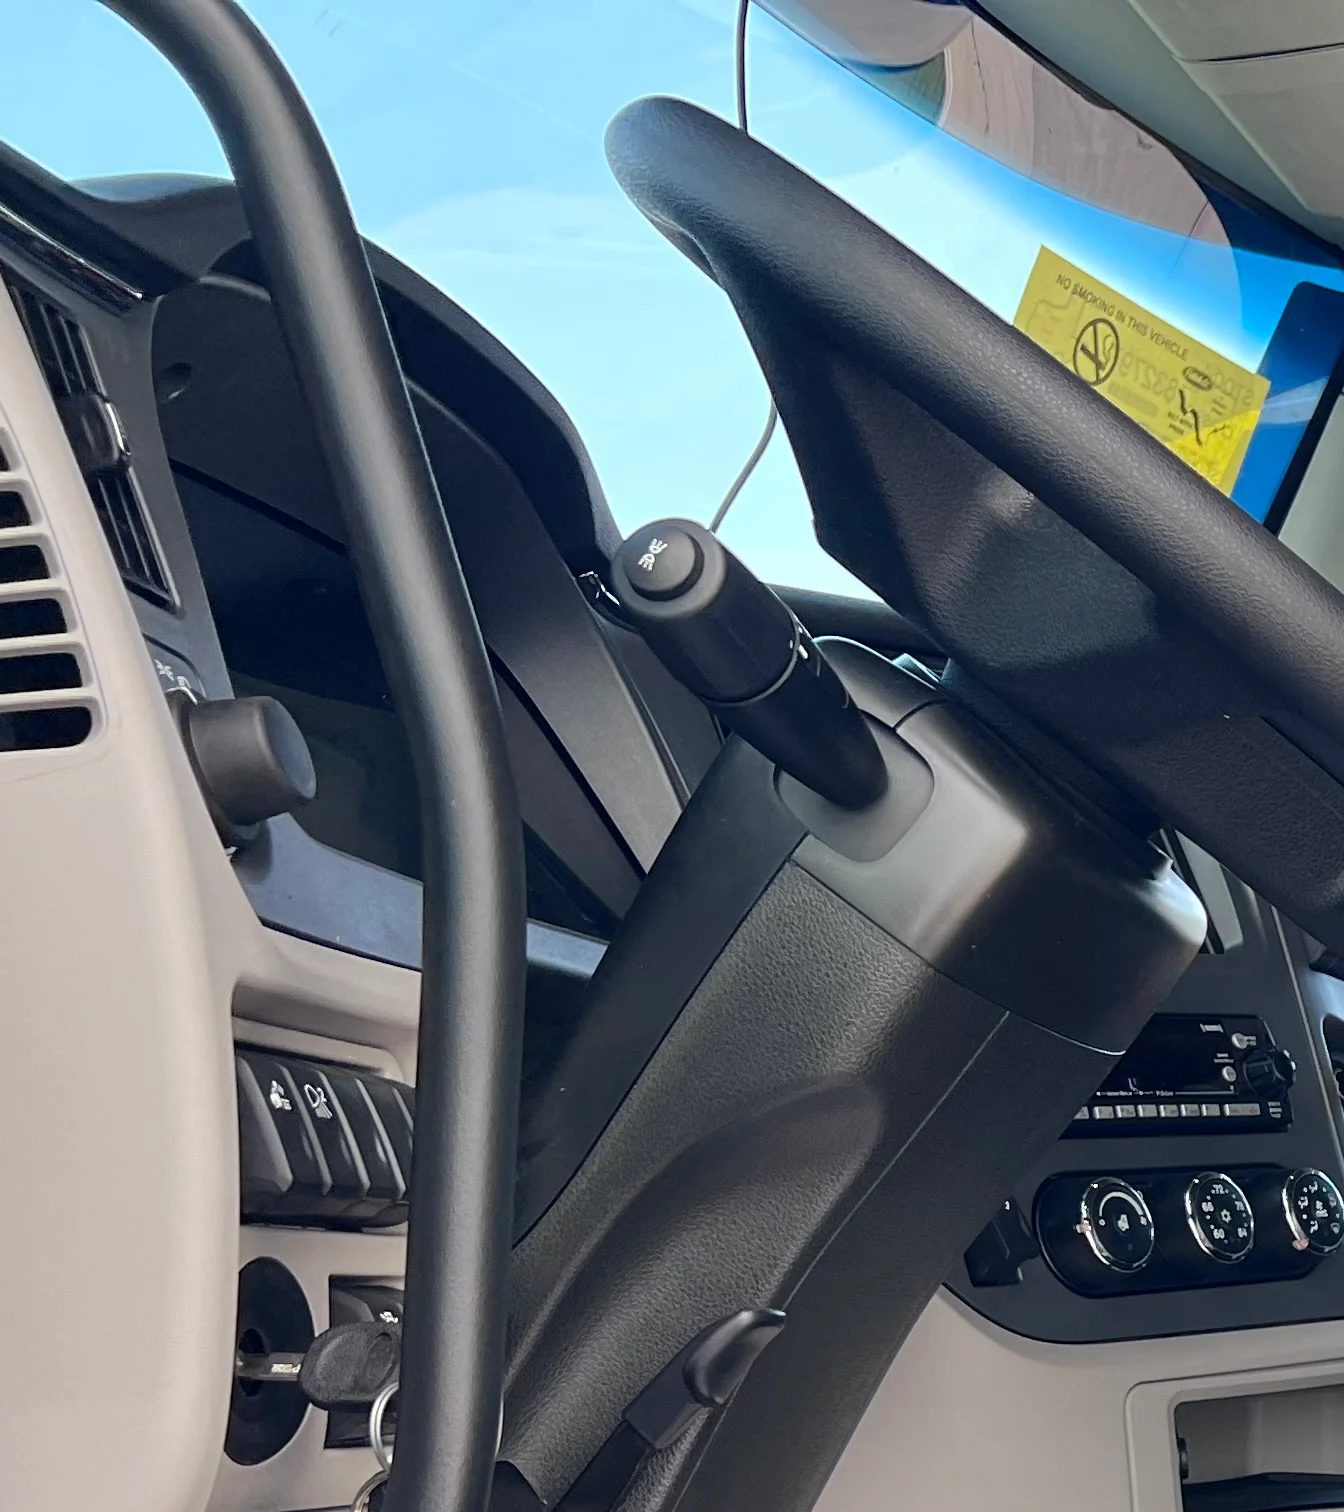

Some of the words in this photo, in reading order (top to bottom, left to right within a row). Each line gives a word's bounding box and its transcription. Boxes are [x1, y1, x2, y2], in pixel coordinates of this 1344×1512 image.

[1057, 273, 1072, 290] NO
[1071, 284, 1116, 318] SMOKING
[1115, 309, 1127, 323] IN
[1126, 315, 1149, 338] THIS
[1149, 330, 1190, 361] VEHICLE
